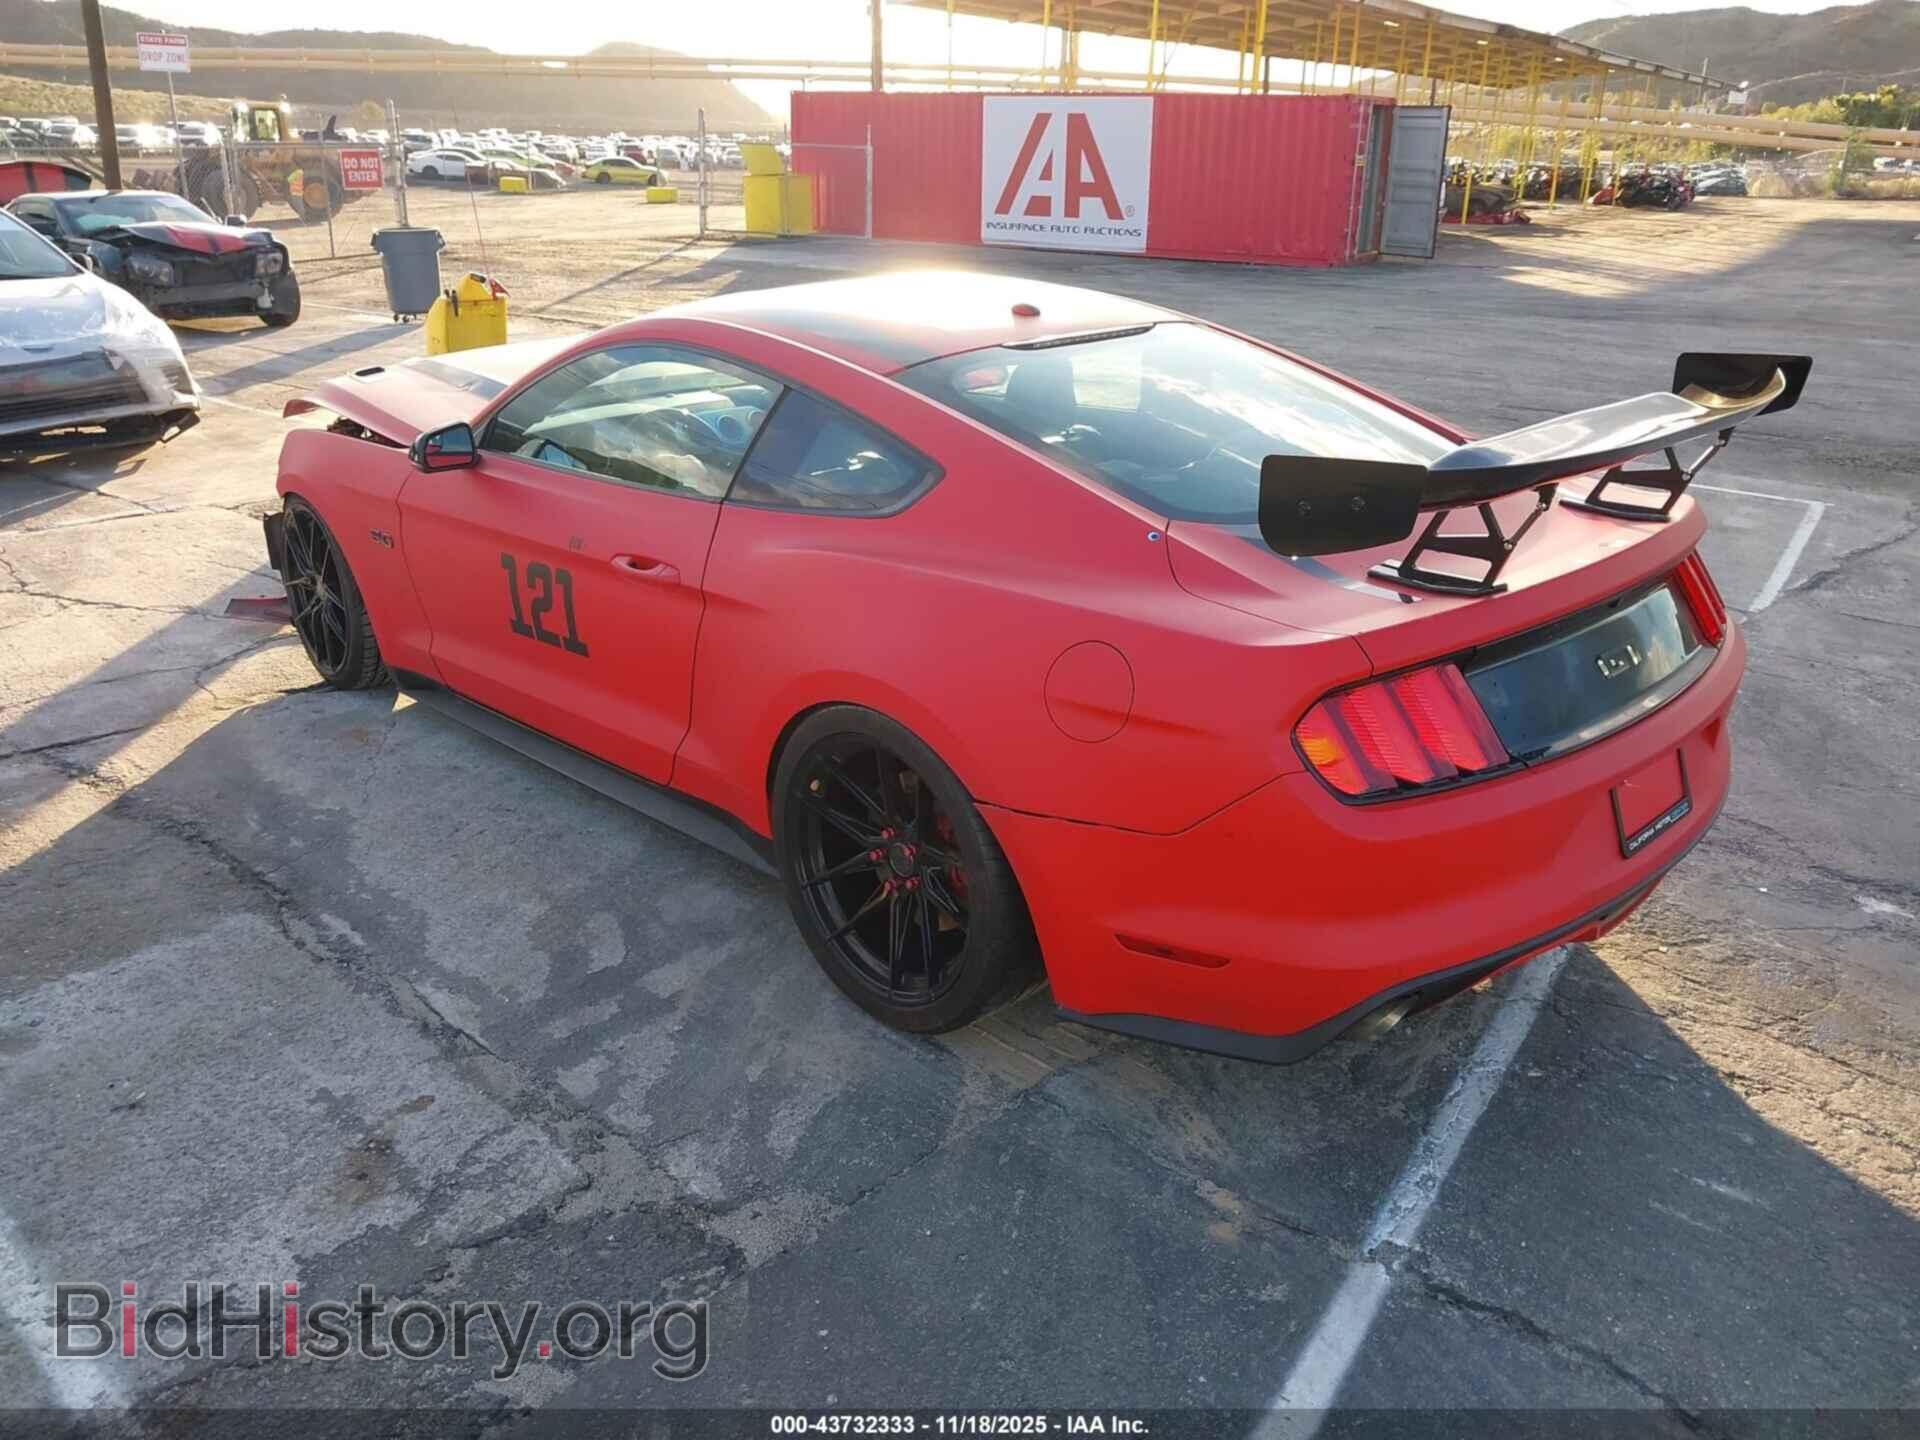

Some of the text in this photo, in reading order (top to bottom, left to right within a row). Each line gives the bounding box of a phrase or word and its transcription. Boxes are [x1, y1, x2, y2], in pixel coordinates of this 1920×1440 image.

[343, 157, 378, 169] DO NOT
[348, 170, 379, 182] ENTER
[986, 221, 1142, 237] INSURANCE AUTO AUCTIONS
[500, 552, 590, 658] 121
